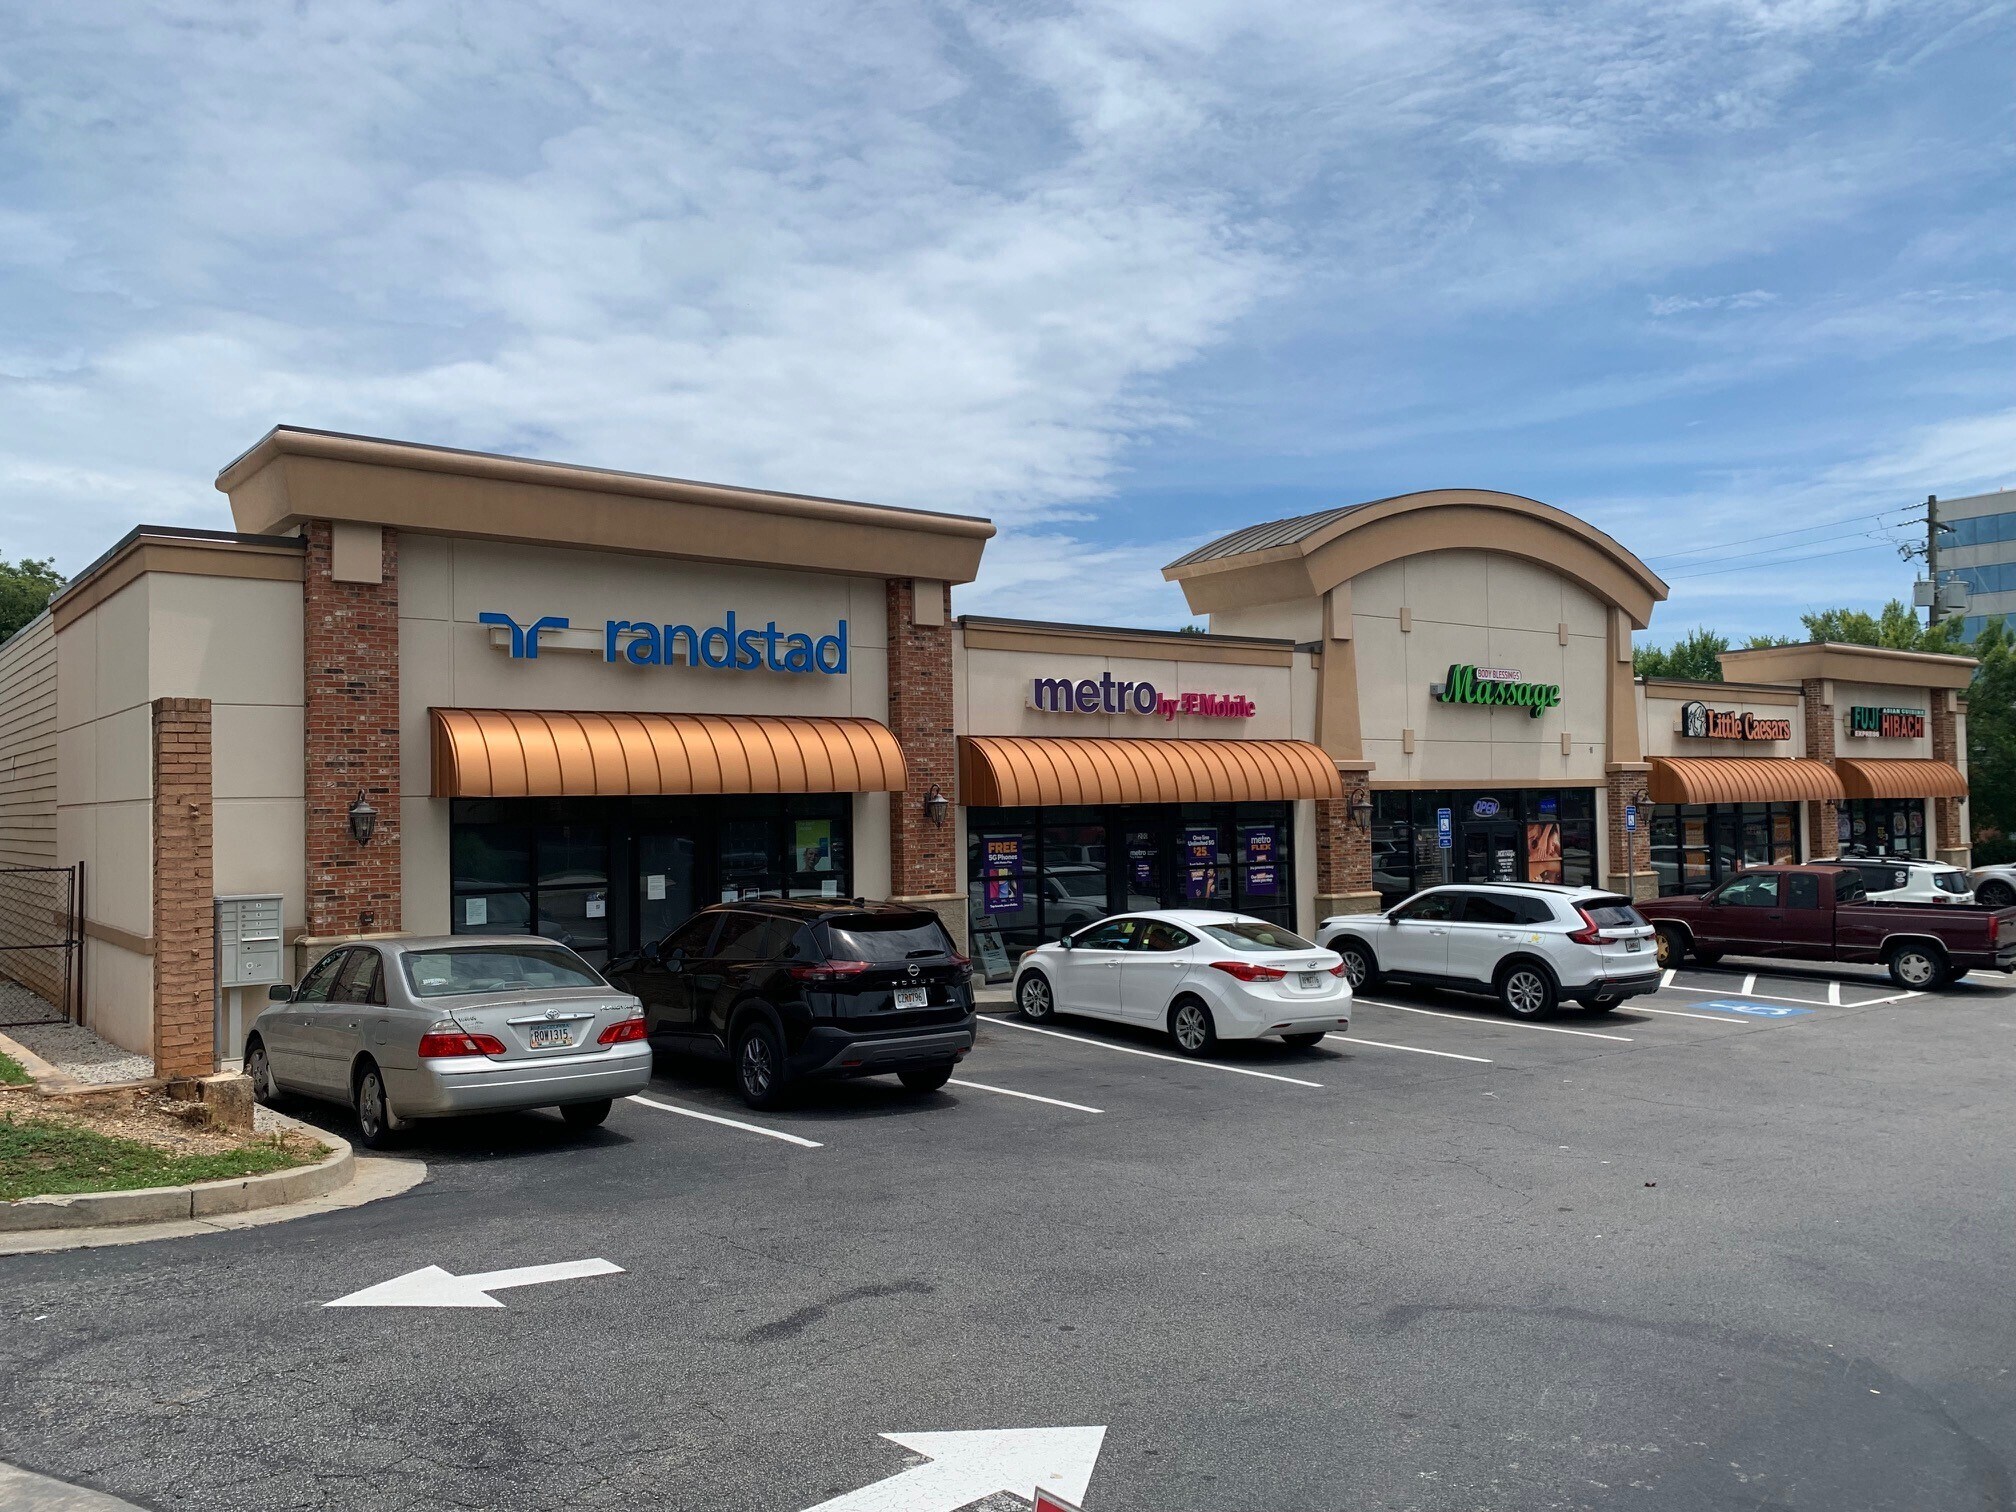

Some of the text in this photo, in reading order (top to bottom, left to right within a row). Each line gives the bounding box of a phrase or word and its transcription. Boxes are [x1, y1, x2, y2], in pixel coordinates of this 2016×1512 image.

[606, 610, 848, 675] randstad
[1478, 669, 1520, 680] BODY BLESSINGS
[1034, 671, 1157, 715] metro
[1156, 693, 1181, 721] by
[1441, 663, 1561, 718] Massage
[1707, 710, 1791, 740] Little Caesars
[1854, 706, 1879, 730] FUJI
[1882, 714, 1925, 738] HIBACHI
[1475, 800, 1498, 815] OPEN
[988, 841, 1018, 854] FREE
[1251, 835, 1272, 844] metro
[997, 853, 1018, 861] Phones
